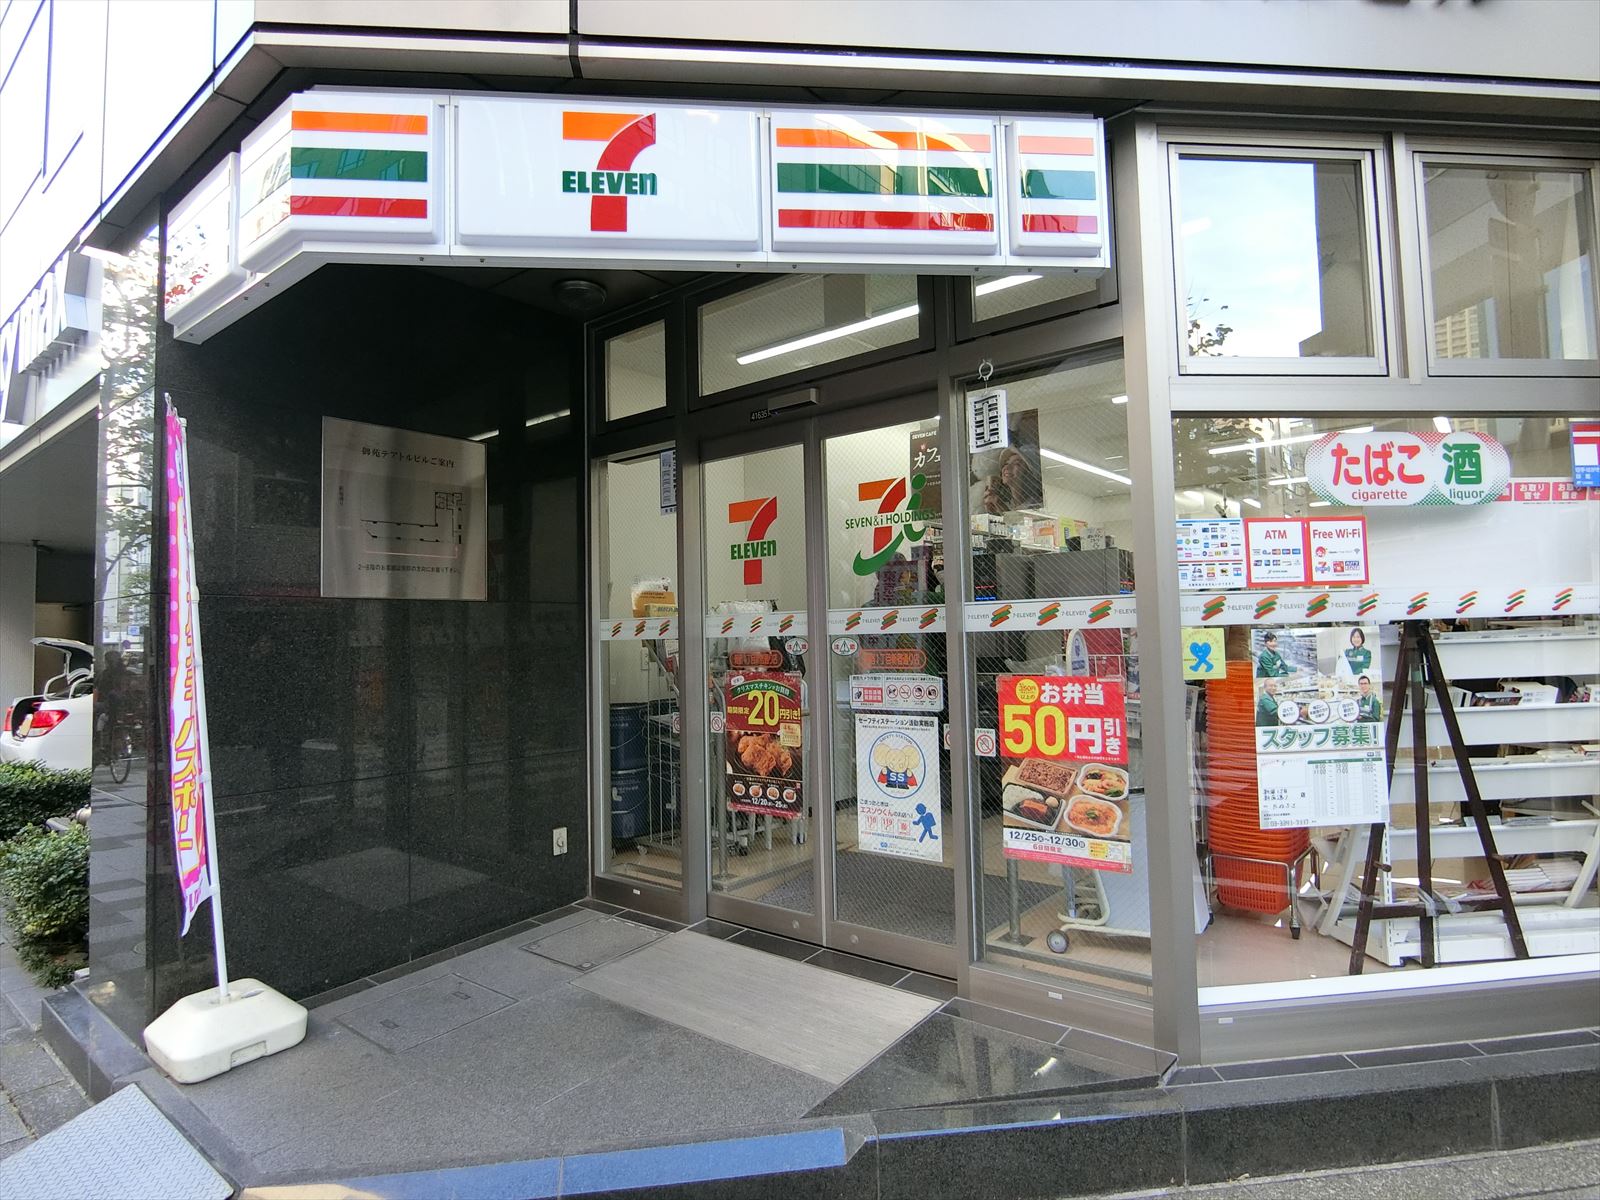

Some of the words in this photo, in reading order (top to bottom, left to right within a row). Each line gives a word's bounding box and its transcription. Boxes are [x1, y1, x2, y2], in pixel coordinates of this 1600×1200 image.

[562, 111, 657, 233] 7
[1330, 440, 1425, 486] たばこ
[1442, 442, 1483, 485] 酒
[1351, 489, 1408, 501] cigarette
[1449, 488, 1485, 500] liquor
[1264, 529, 1288, 540] ATM
[1312, 528, 1334, 539] Free
[1335, 527, 1361, 538] Wi-Fi
[1040, 682, 1105, 706] お弁当
[747, 689, 780, 727] 20
[1003, 704, 1103, 756] 50円
[1262, 725, 1379, 749] スタッフ募集!
[889, 772, 905, 782] SS
